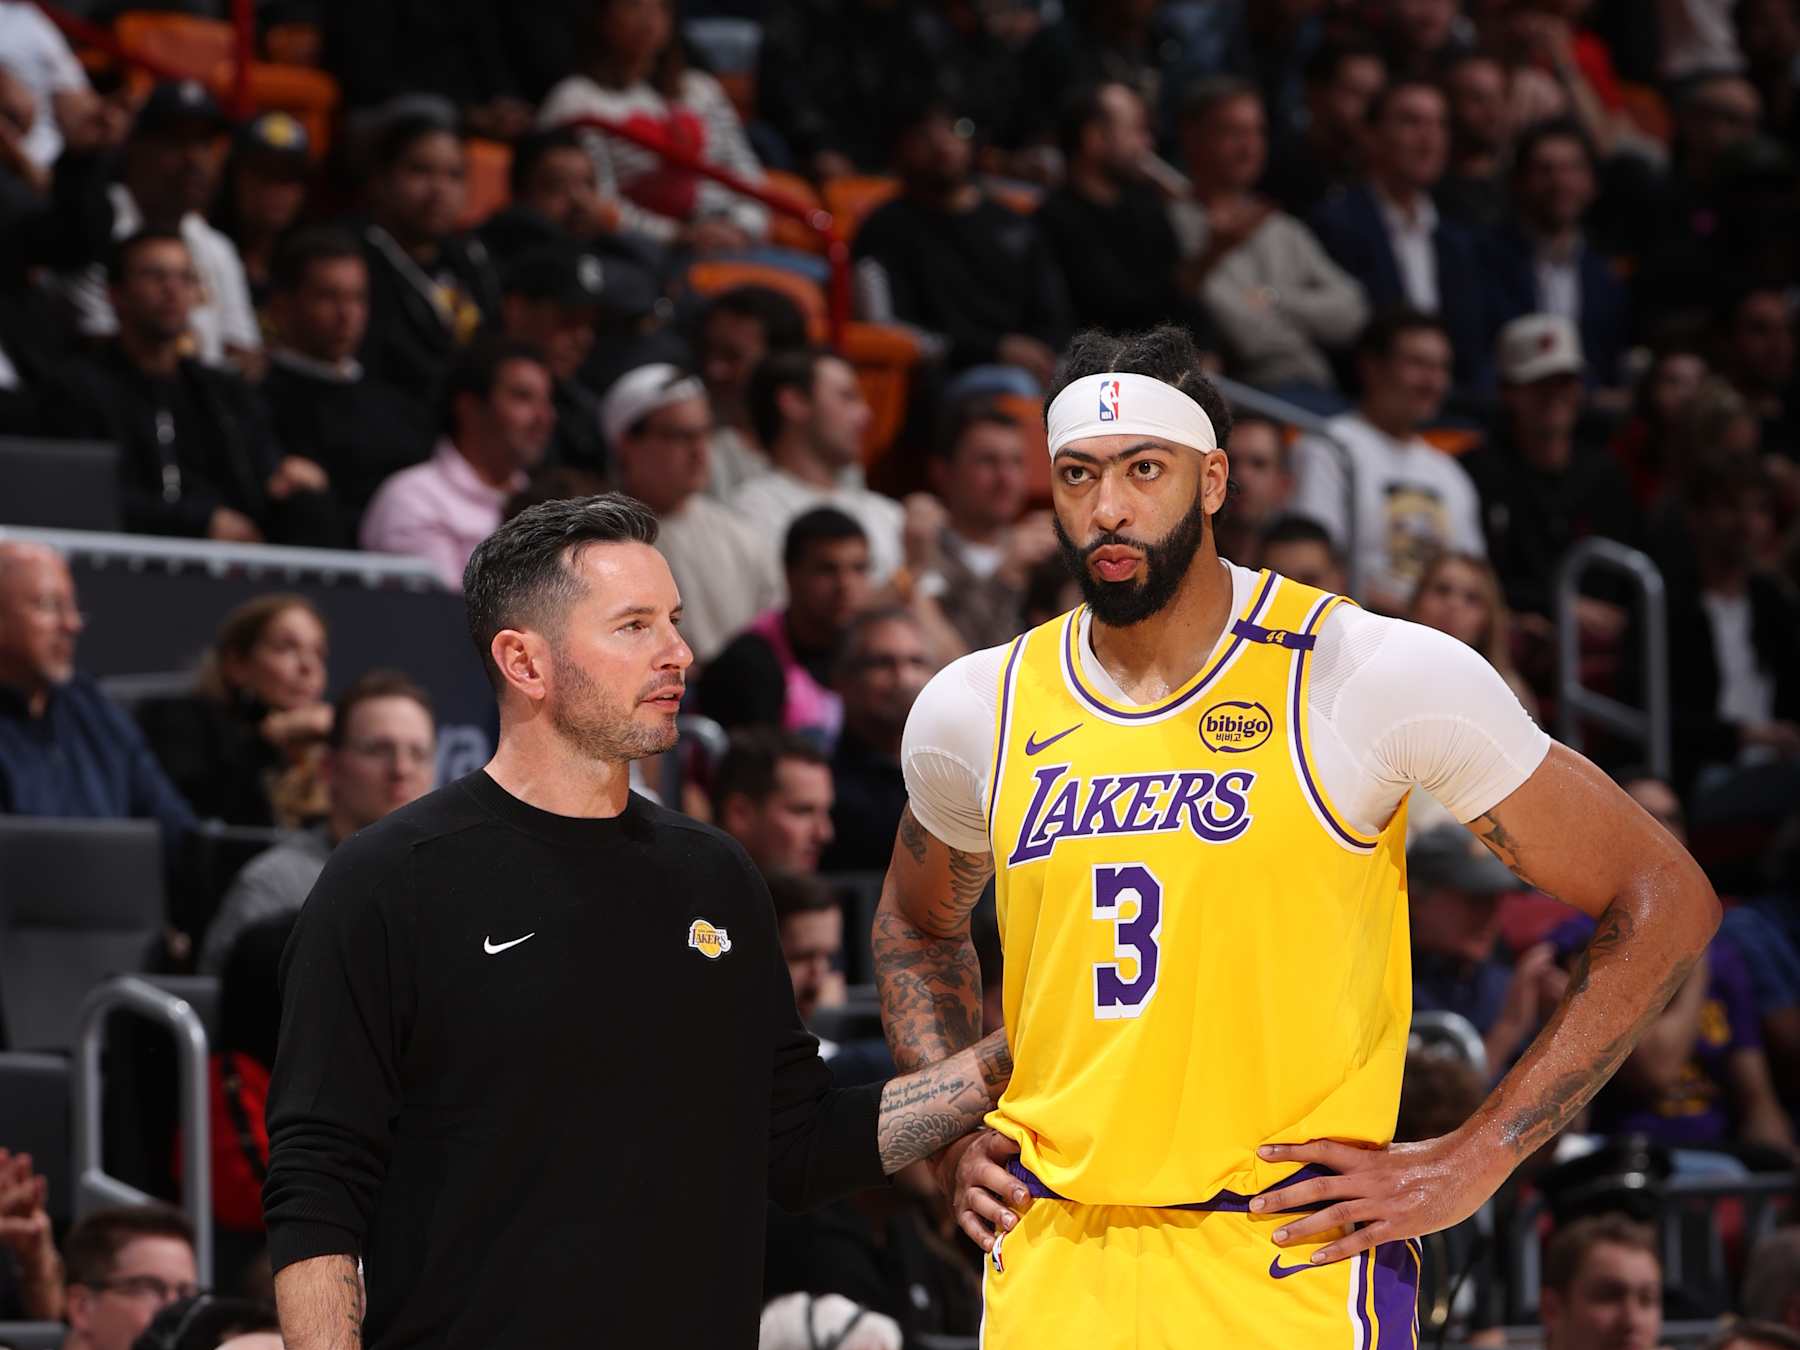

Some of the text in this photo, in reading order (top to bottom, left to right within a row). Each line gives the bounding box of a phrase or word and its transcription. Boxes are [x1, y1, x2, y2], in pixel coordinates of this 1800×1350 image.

[1265, 630, 1287, 643] 44
[1206, 715, 1268, 738] bibigo
[1215, 733, 1242, 742] 비비고
[1007, 762, 1257, 868] LAKERS
[1092, 863, 1163, 1020] 3
